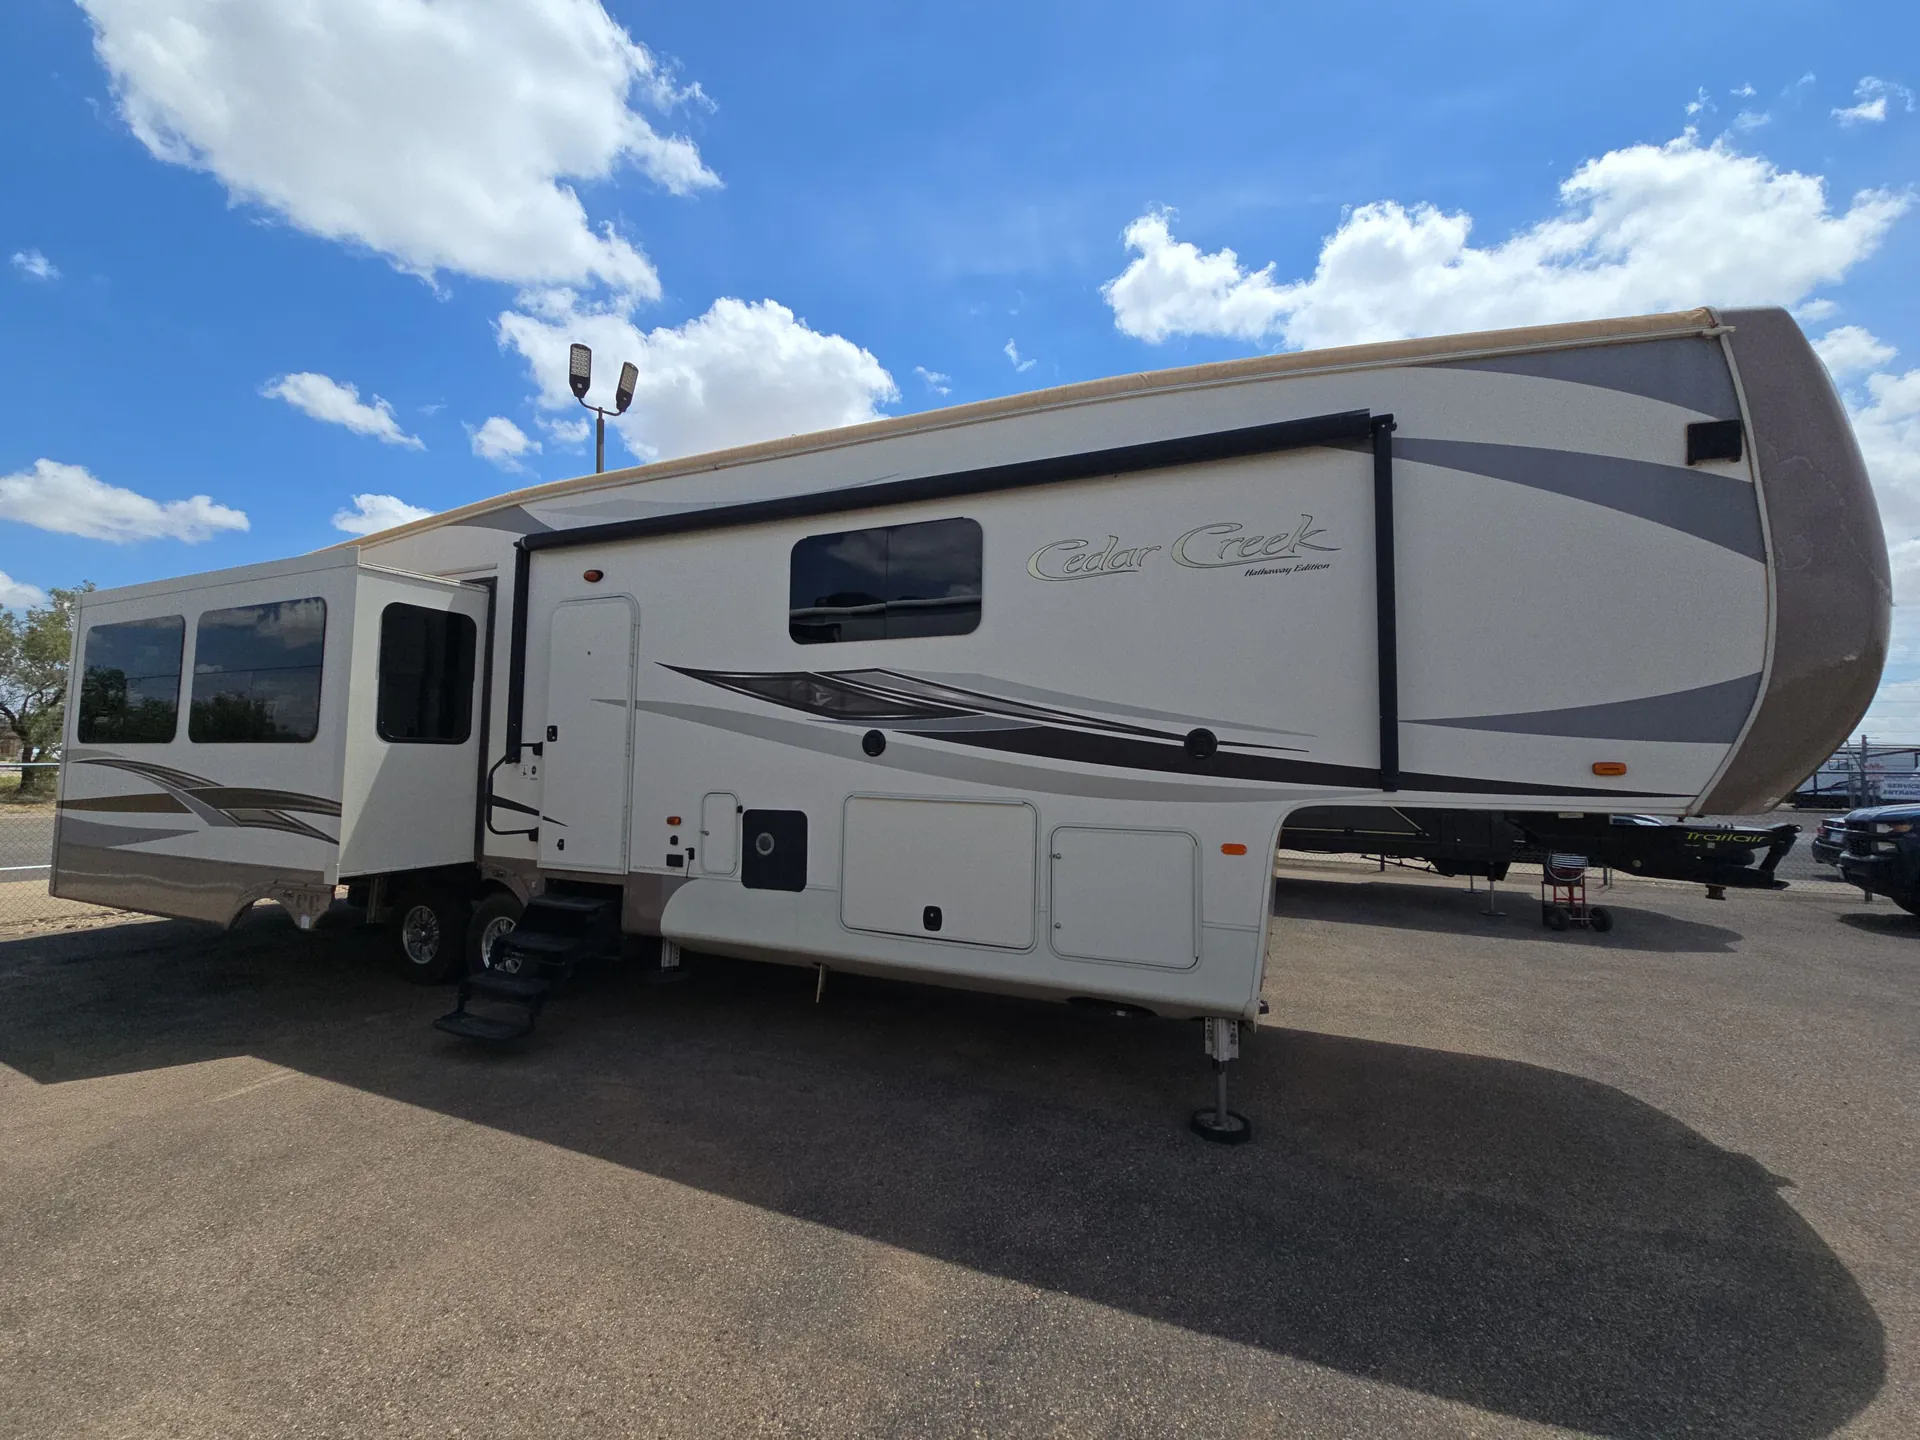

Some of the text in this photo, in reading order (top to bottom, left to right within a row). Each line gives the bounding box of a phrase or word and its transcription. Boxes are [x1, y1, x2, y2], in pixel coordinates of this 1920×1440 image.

[1026, 514, 1342, 582] Cedar Creek
[1244, 563, 1331, 577] Hathaway Edition
[1684, 831, 1768, 843] Trailair
